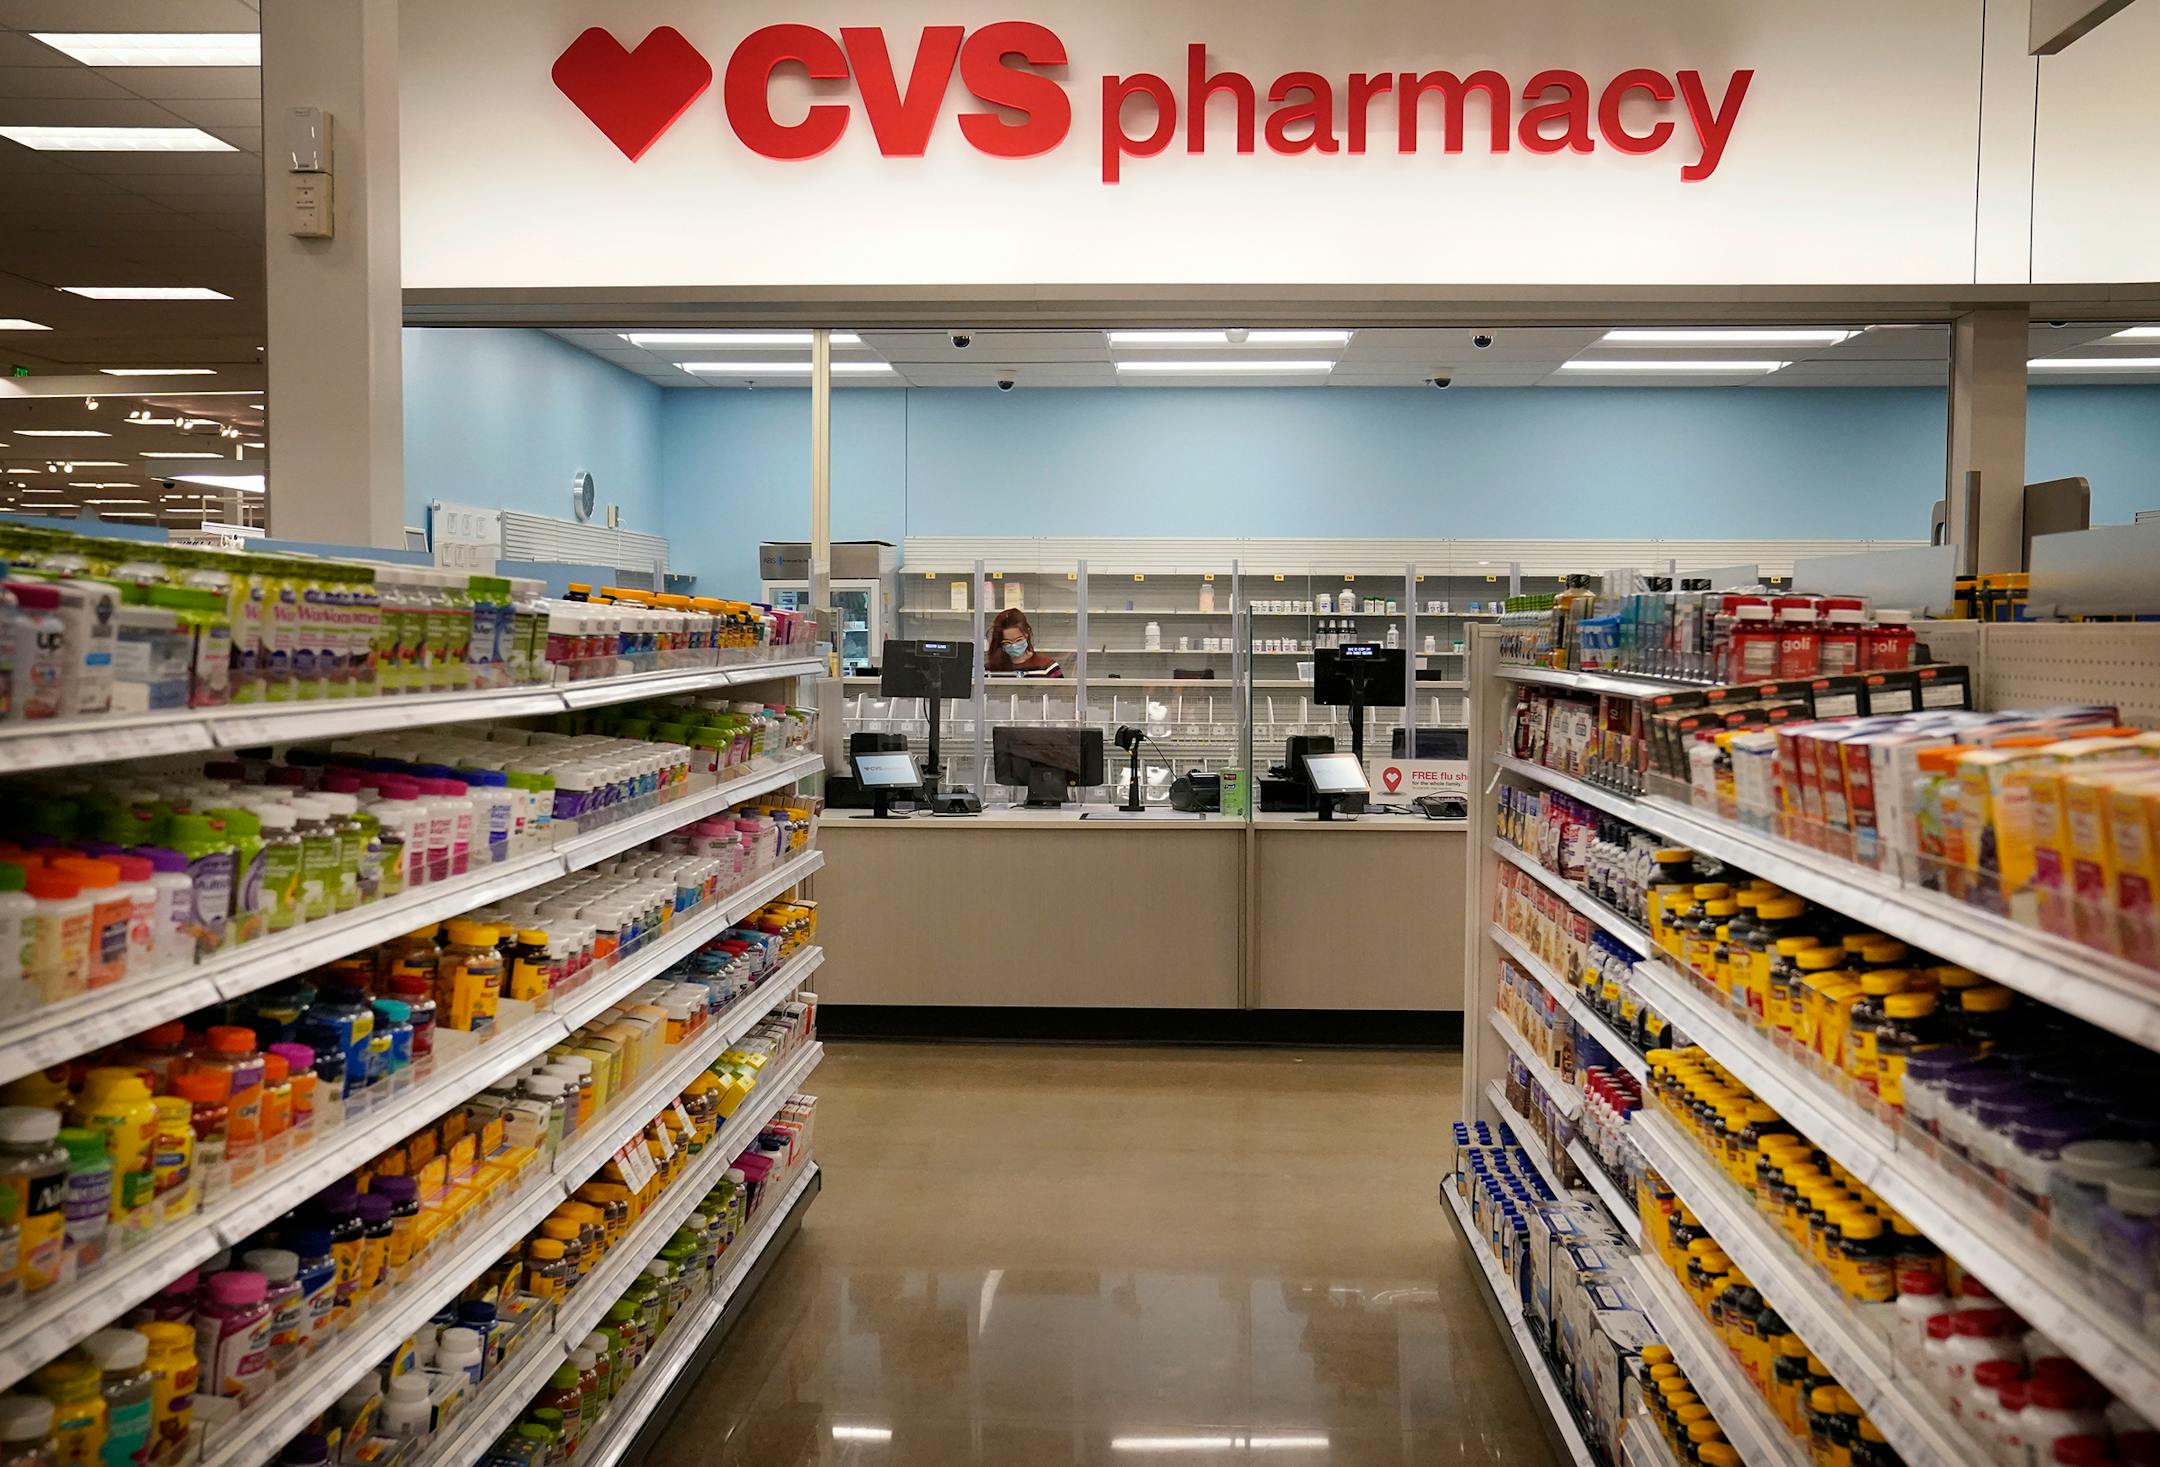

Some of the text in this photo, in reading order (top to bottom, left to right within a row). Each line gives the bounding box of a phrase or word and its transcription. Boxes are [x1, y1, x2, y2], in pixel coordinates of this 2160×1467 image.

[723, 21, 1754, 185] CVS pharmacy
[1782, 637, 1811, 653] goli
[1412, 771, 1438, 780] FREE
[1440, 771, 1453, 780] flu
